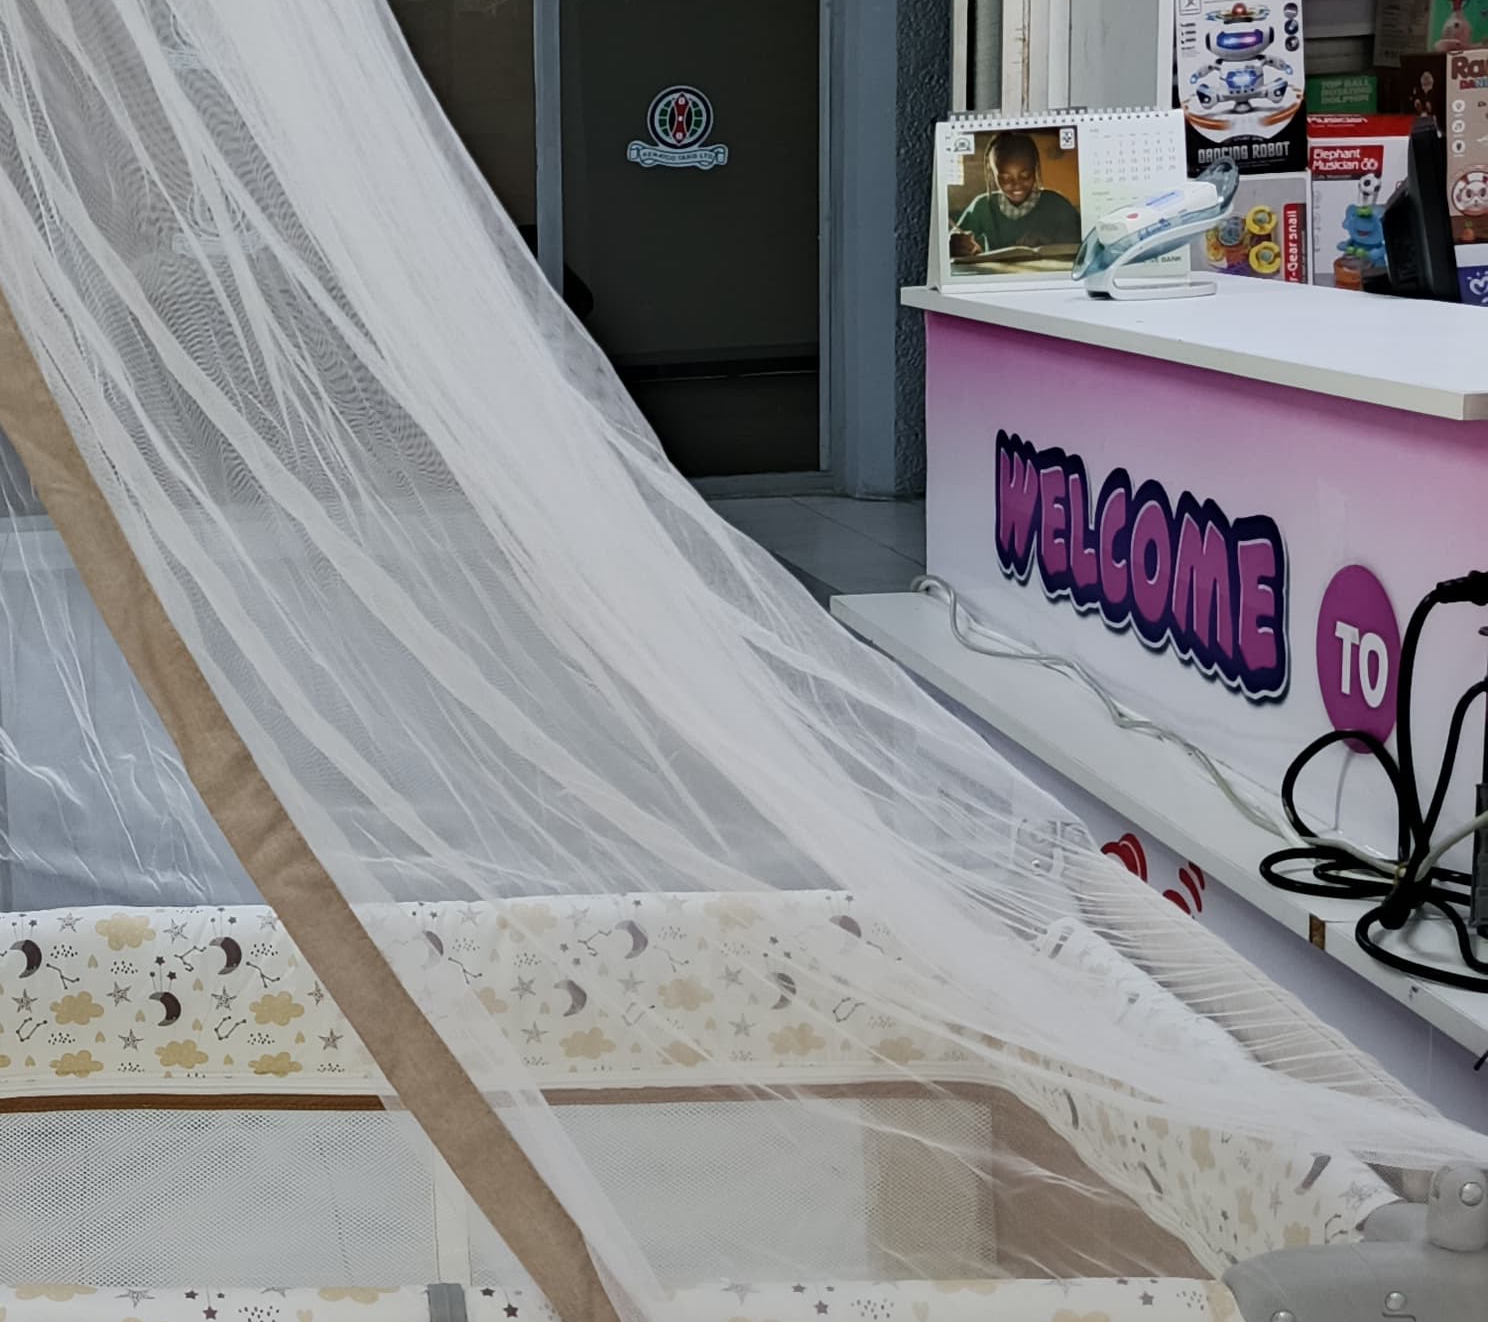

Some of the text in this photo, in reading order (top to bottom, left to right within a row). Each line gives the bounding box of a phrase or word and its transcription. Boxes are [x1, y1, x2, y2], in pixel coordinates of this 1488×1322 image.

[1252, 141, 1290, 159] ROBOT
[1313, 149, 1360, 160] Elephant
[1313, 161, 1359, 170] Musician
[1286, 210, 1298, 240] snail
[996, 432, 1286, 697] WELCOME
[1335, 621, 1389, 708] TO
